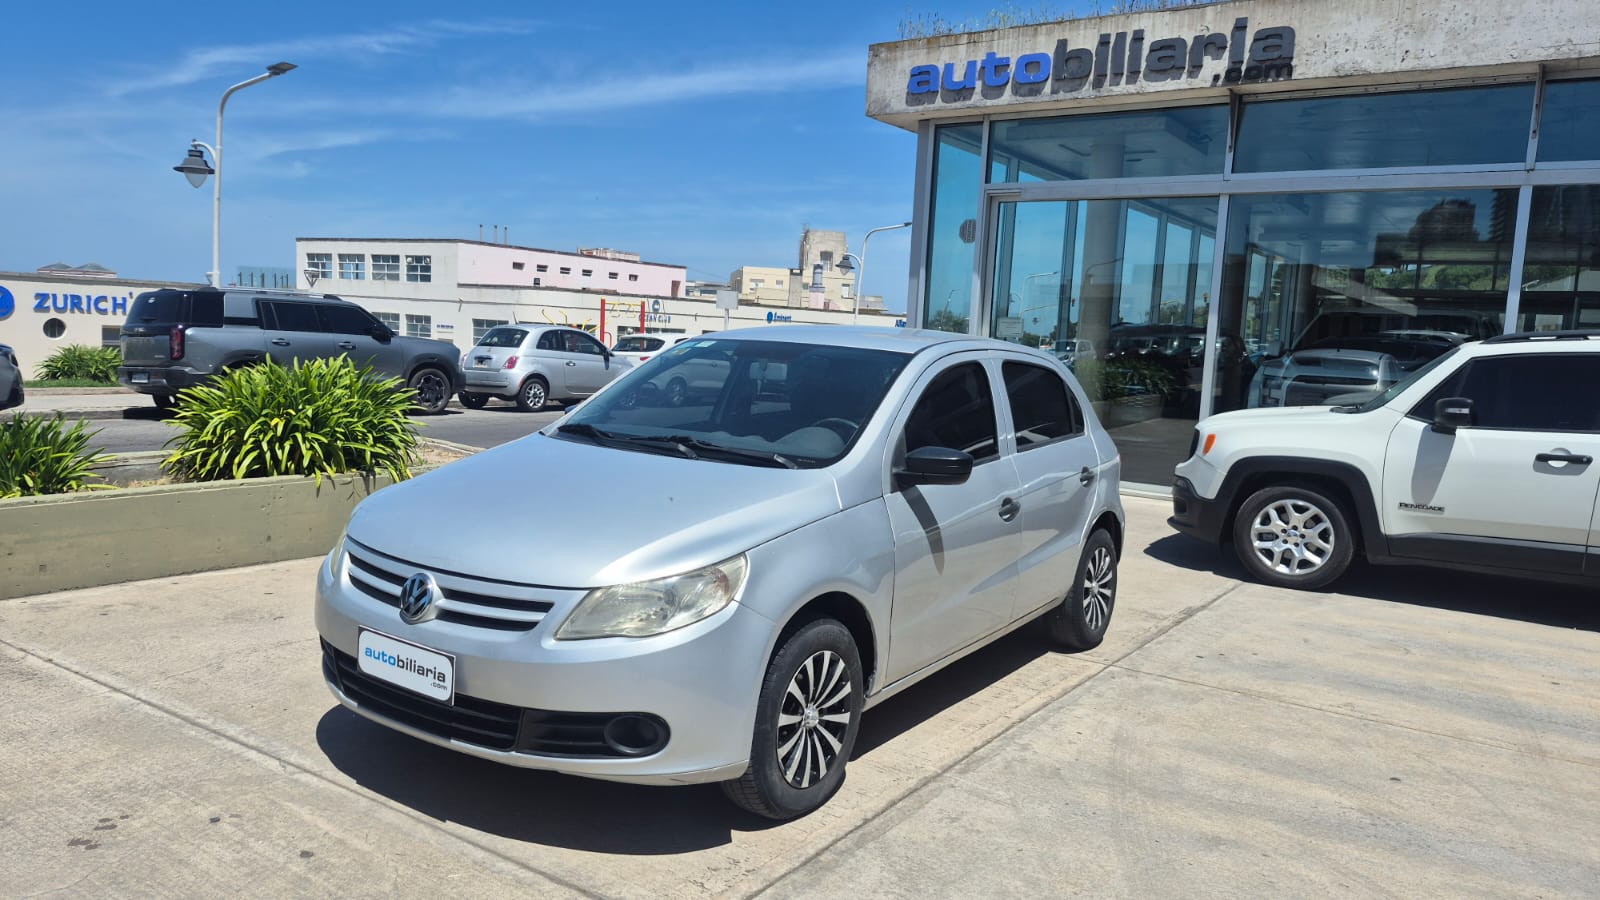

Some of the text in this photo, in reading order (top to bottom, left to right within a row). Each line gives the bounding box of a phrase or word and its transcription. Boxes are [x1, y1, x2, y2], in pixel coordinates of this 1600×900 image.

[908, 17, 1296, 94] autobiliaria
[1213, 62, 1293, 83] .com
[33, 292, 128, 315] ZURICH
[1399, 502, 1445, 513] RENEGADE
[364, 647, 446, 683] autobiliaria
[431, 682, 447, 691] .com
